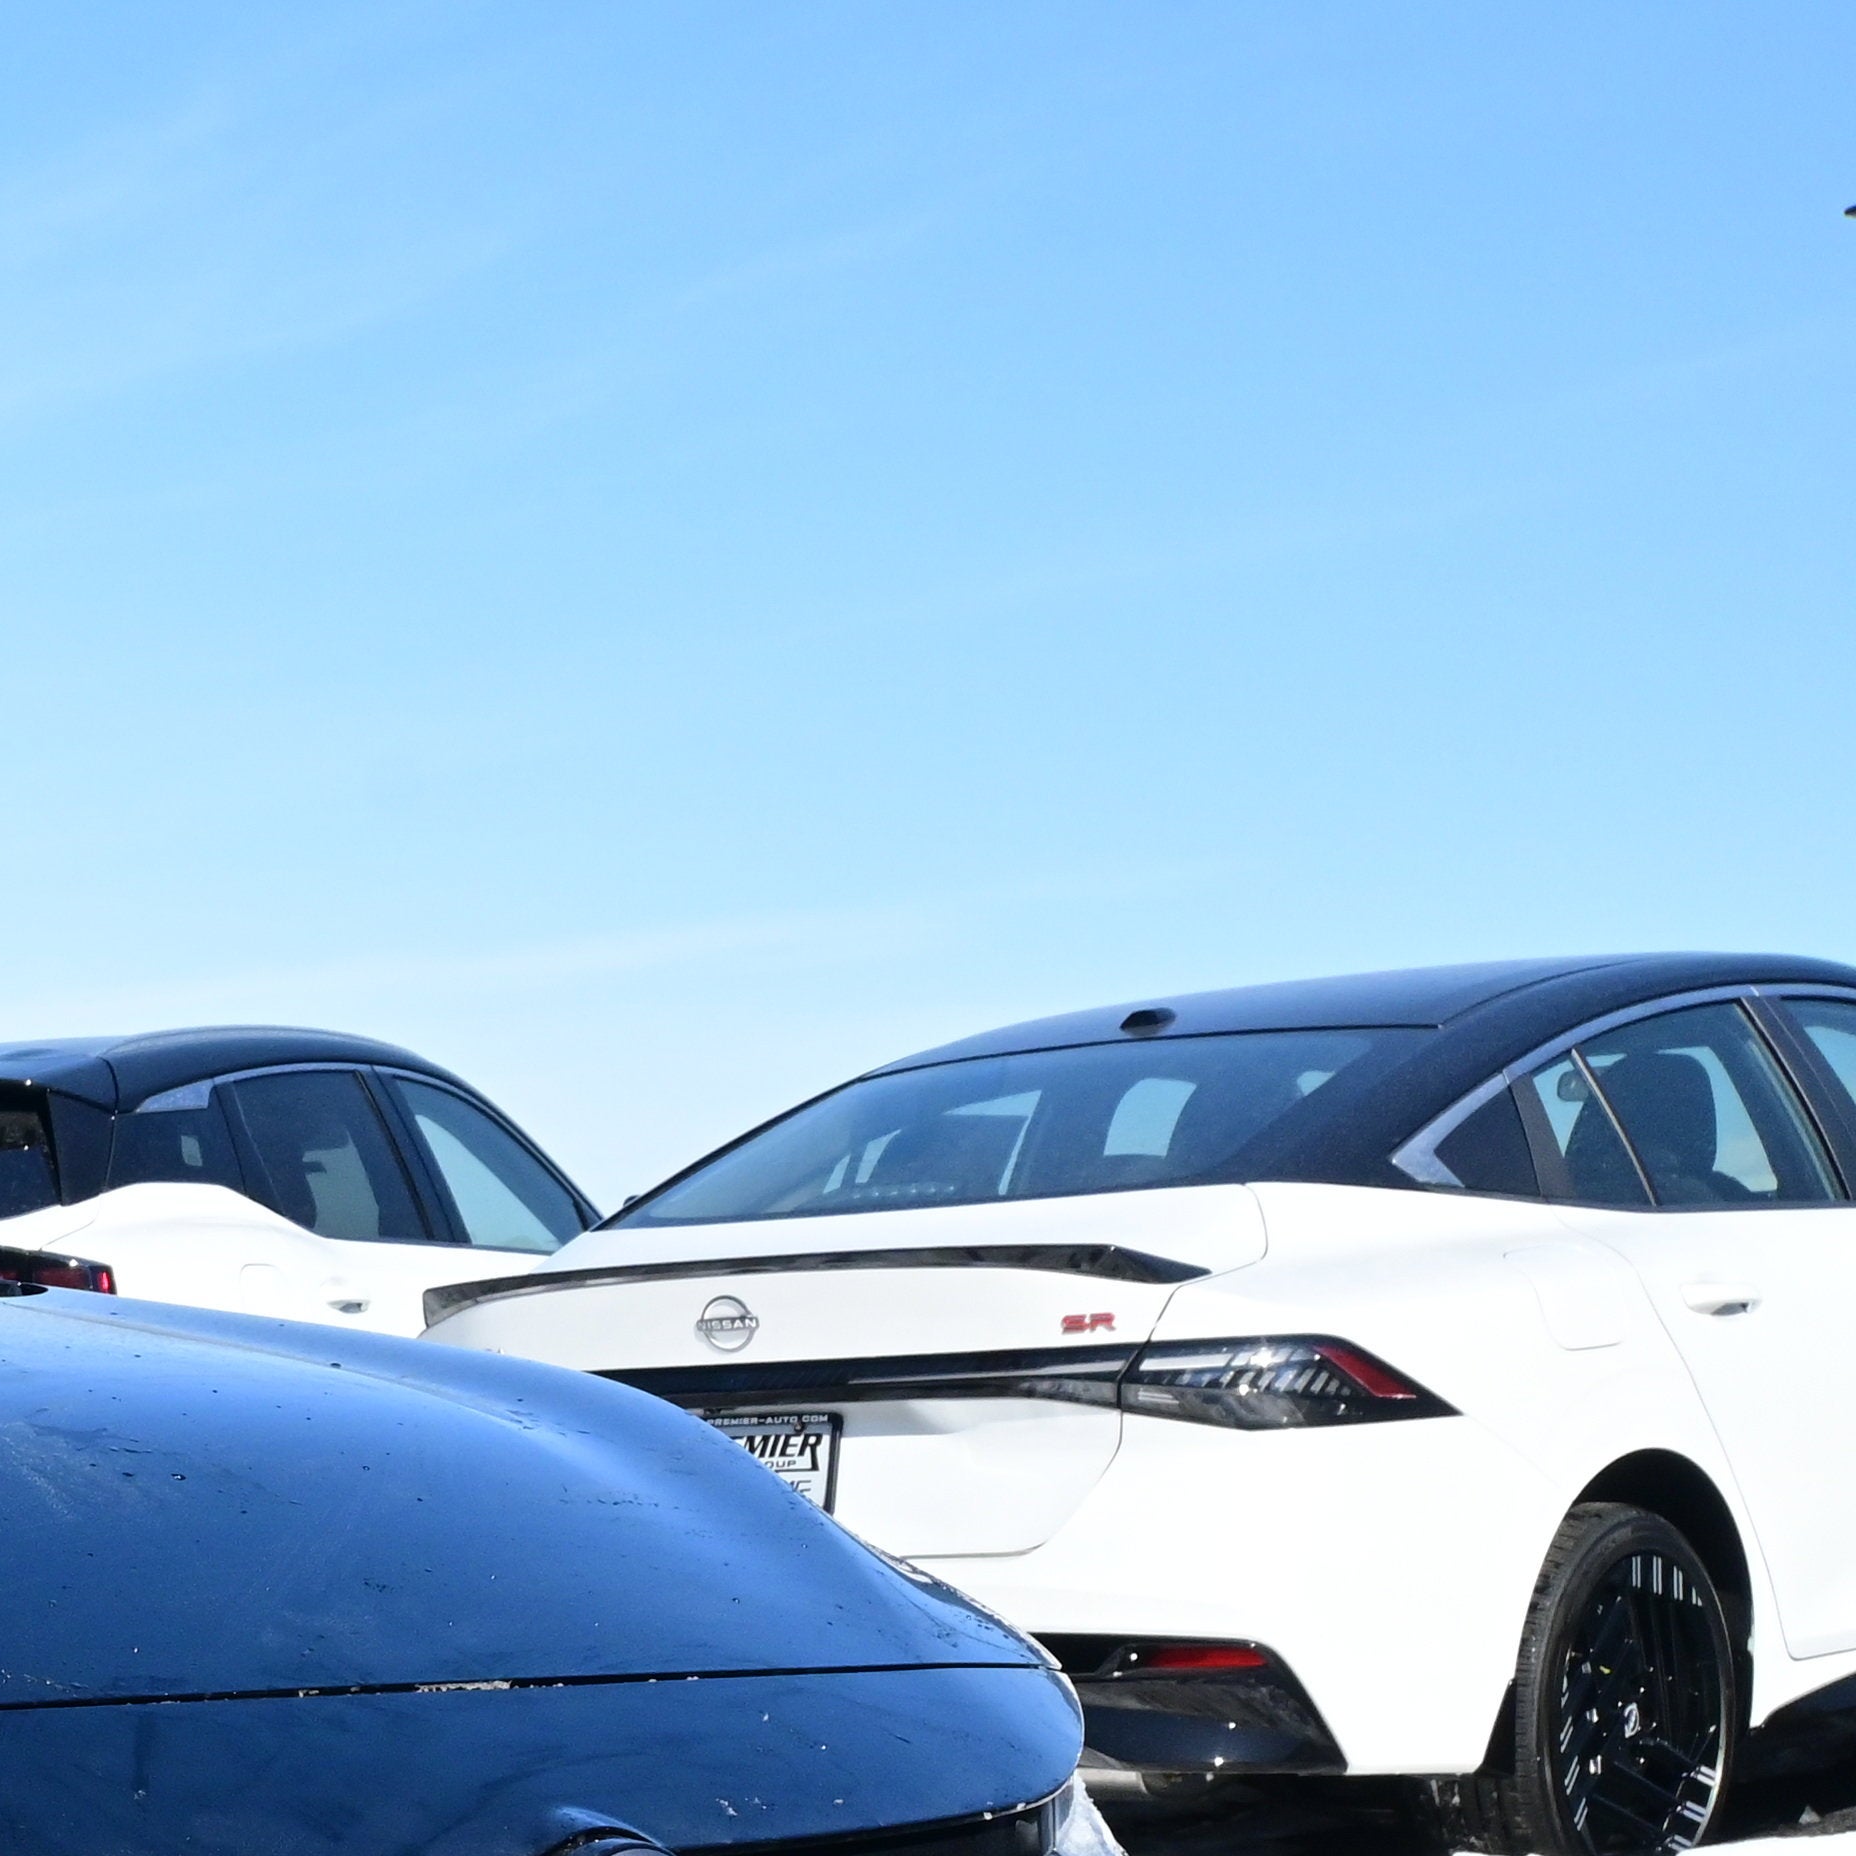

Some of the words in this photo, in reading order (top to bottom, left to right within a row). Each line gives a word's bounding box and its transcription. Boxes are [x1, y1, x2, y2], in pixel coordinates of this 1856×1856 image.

[697, 1319, 757, 1330] NISSAN
[1061, 1312, 1116, 1335] SR
[707, 1414, 828, 1426] PREMIER-AUTOCOM
[745, 1433, 823, 1471] MIER
[765, 1460, 797, 1468] OUP
